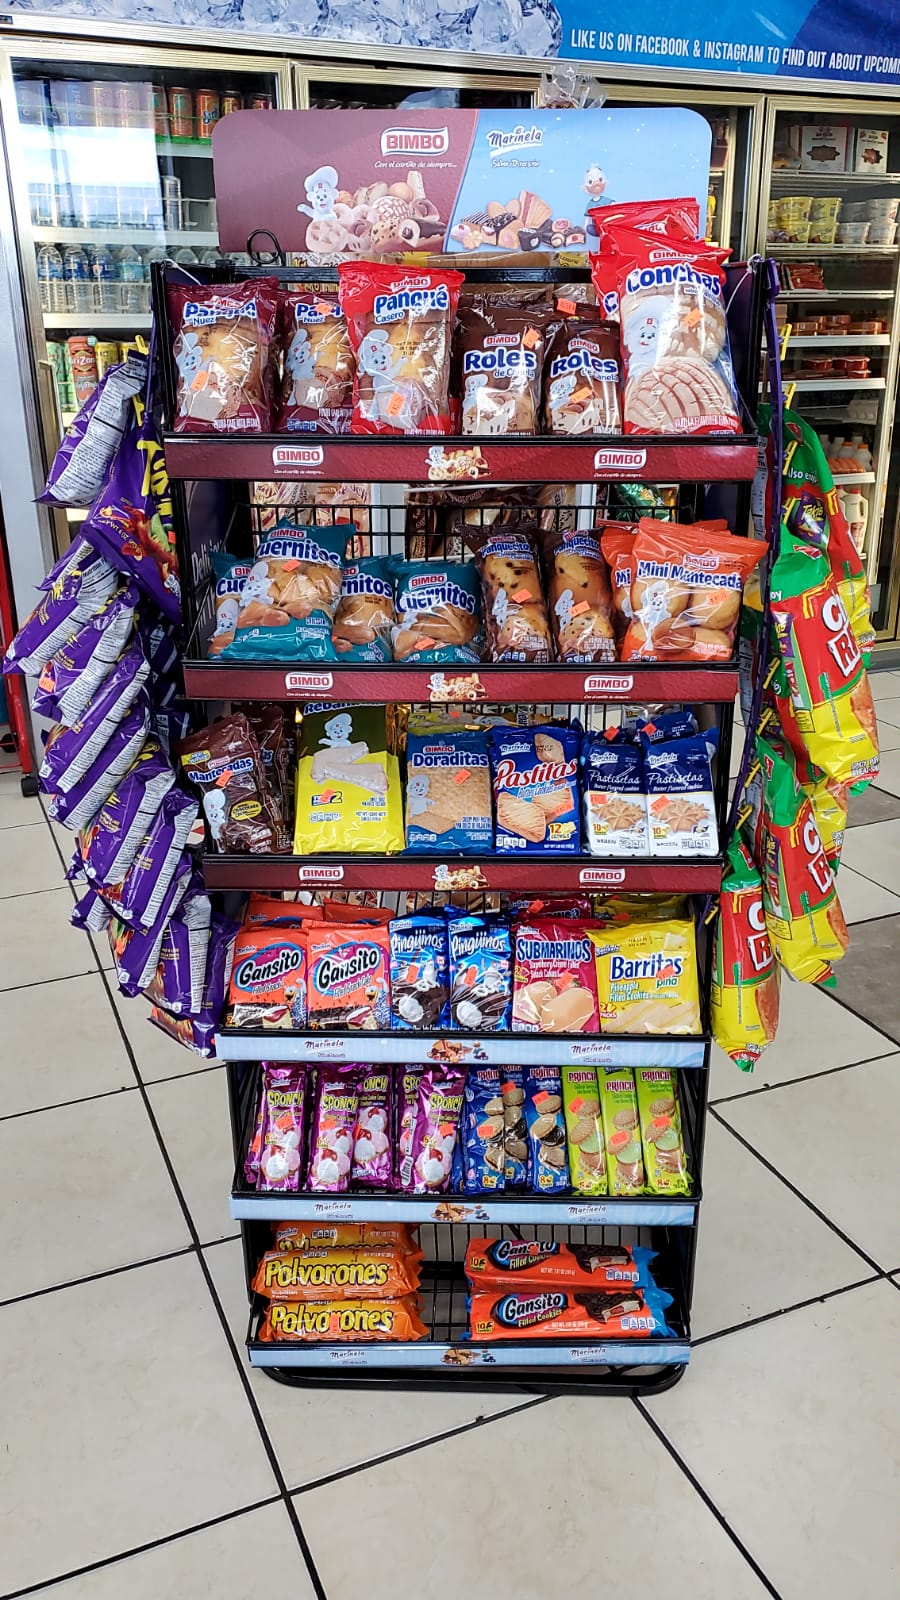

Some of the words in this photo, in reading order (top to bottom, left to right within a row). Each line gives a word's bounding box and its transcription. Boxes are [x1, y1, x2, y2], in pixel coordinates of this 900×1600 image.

[571, 29, 596, 49] LIKE
[599, 32, 614, 51] US
[617, 34, 633, 52] ON
[636, 35, 690, 57] FACEBOOK
[693, 40, 701, 56] &
[704, 41, 764, 63] INSTAGRAM
[767, 46, 780, 64] TO
[782, 48, 805, 66] FIND
[807, 50, 827, 69] OUT
[830, 52, 863, 71] ABOUT
[386, 134, 445, 149] BIMBO
[489, 128, 543, 147] Marinela
[627, 262, 721, 295] Conchas
[375, 287, 448, 315] Panqué
[193, 317, 217, 326] Nuez
[303, 316, 326, 324] Nuez
[375, 310, 404, 324] Casero
[486, 336, 518, 345] BIMBO
[570, 340, 599, 352] BIMBO
[465, 348, 536, 371] Roles
[553, 350, 617, 375] Roles
[277, 451, 320, 461] BIMBO
[599, 454, 643, 465] BIMBO
[270, 530, 304, 538] BIMBO
[686, 556, 718, 568] BIMBO
[638, 562, 669, 578] Mini
[411, 576, 445, 586] BIMBO
[397, 583, 475, 614] Cuernitos
[289, 677, 330, 686] BIMBO
[588, 679, 630, 689] BIMBO
[412, 752, 488, 768] Doraditas
[189, 758, 253, 782] Mantecadas
[495, 760, 577, 790] Pastitas
[549, 825, 561, 833] 12
[302, 869, 341, 878] BIMBO
[583, 871, 622, 880] BIMBO
[391, 930, 444, 954] Pingüinos
[451, 932, 505, 961] Pingüinos
[516, 939, 592, 962] SUBMARINOS
[240, 951, 299, 986] Gansito
[319, 949, 378, 991] Gansito
[611, 954, 682, 980] Barritas
[610, 993, 625, 1002] Filled
[305, 1039, 344, 1049] Marinela
[571, 1044, 612, 1054] Marinela
[267, 1091, 303, 1107] SPONCH
[322, 1095, 358, 1112] SPONCH
[429, 1094, 464, 1110] SPONCH
[314, 1202, 352, 1211] Marinela
[570, 1205, 607, 1214] Marinela
[471, 1258, 479, 1266] 10
[510, 1258, 527, 1269] Filled
[265, 1258, 388, 1288] Polvorones
[505, 1293, 562, 1322] Gansito
[519, 1316, 536, 1327] Filled
[537, 1309, 563, 1321] Cookies
[571, 1346, 606, 1357] Marinela
